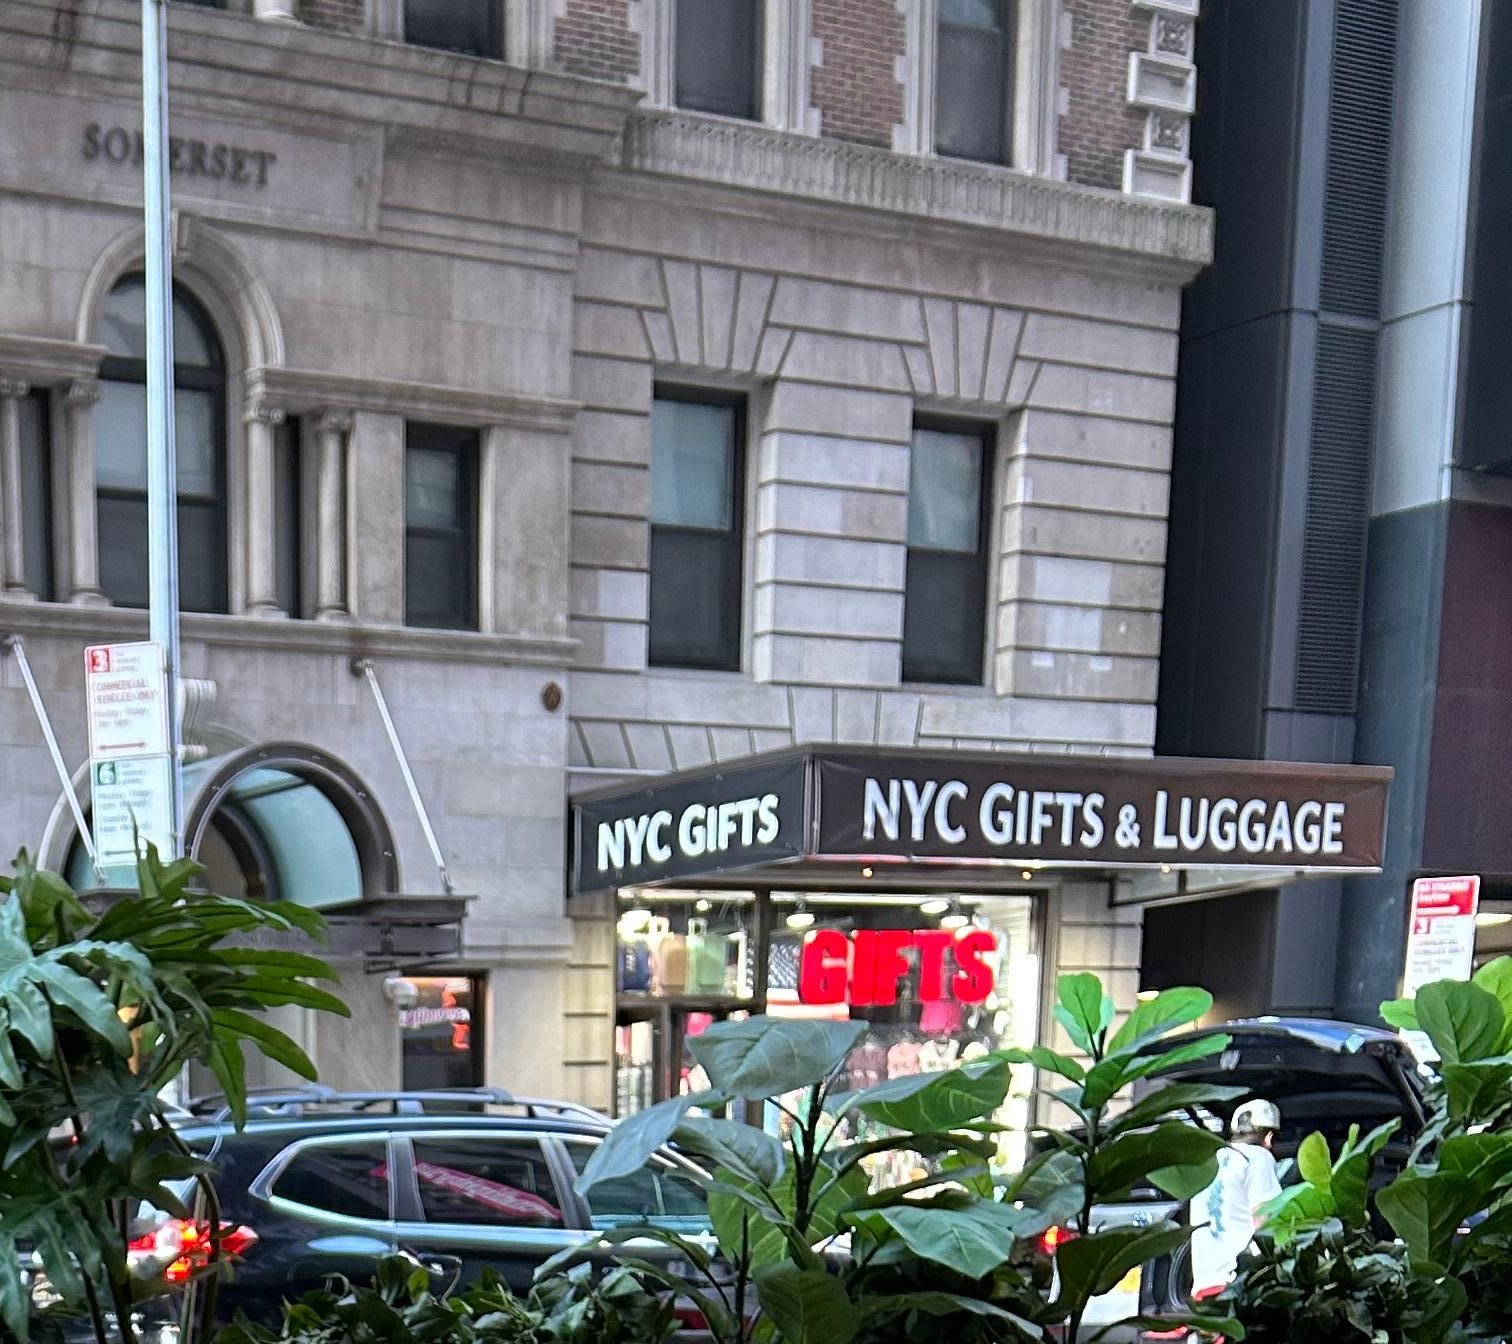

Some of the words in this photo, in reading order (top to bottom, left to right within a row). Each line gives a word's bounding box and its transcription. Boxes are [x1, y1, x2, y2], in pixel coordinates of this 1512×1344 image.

[597, 810, 673, 872] NYC
[678, 794, 780, 857] GIFTS
[862, 777, 969, 843] NYC
[979, 781, 1105, 847] GIFTS
[1114, 802, 1141, 849] &
[1153, 789, 1346, 854] LUGGAGE
[799, 928, 997, 1006] GIFTS
